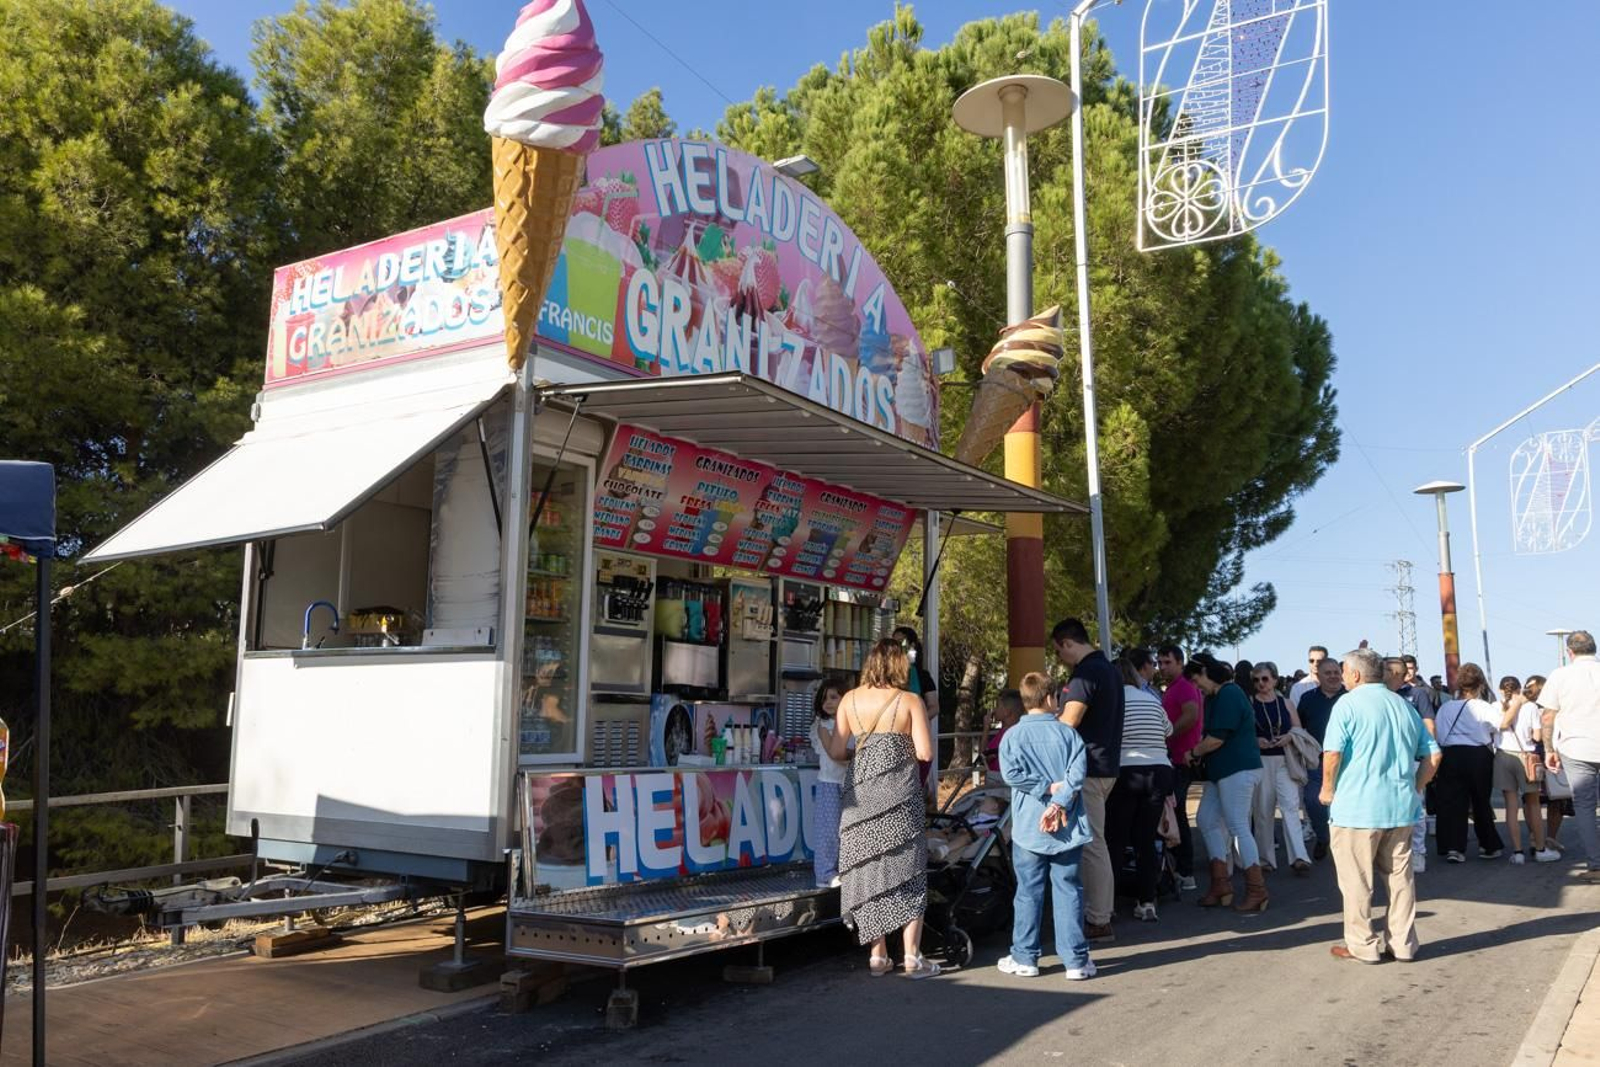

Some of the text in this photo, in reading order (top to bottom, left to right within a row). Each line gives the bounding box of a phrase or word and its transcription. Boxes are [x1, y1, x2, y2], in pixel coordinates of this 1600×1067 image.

[643, 139, 886, 335] HELADERIA
[289, 225, 499, 316] HELADERIA
[538, 299, 614, 345] FRANCIS
[625, 268, 897, 435] GRANIZADOS
[629, 434, 676, 456] HELADOS
[695, 456, 760, 482] GRANIZADOS
[603, 479, 664, 500] CHOCOLATE
[697, 481, 738, 501] PITUFO
[820, 491, 867, 512] GRANIZADOS
[680, 495, 712, 511] FRESA
